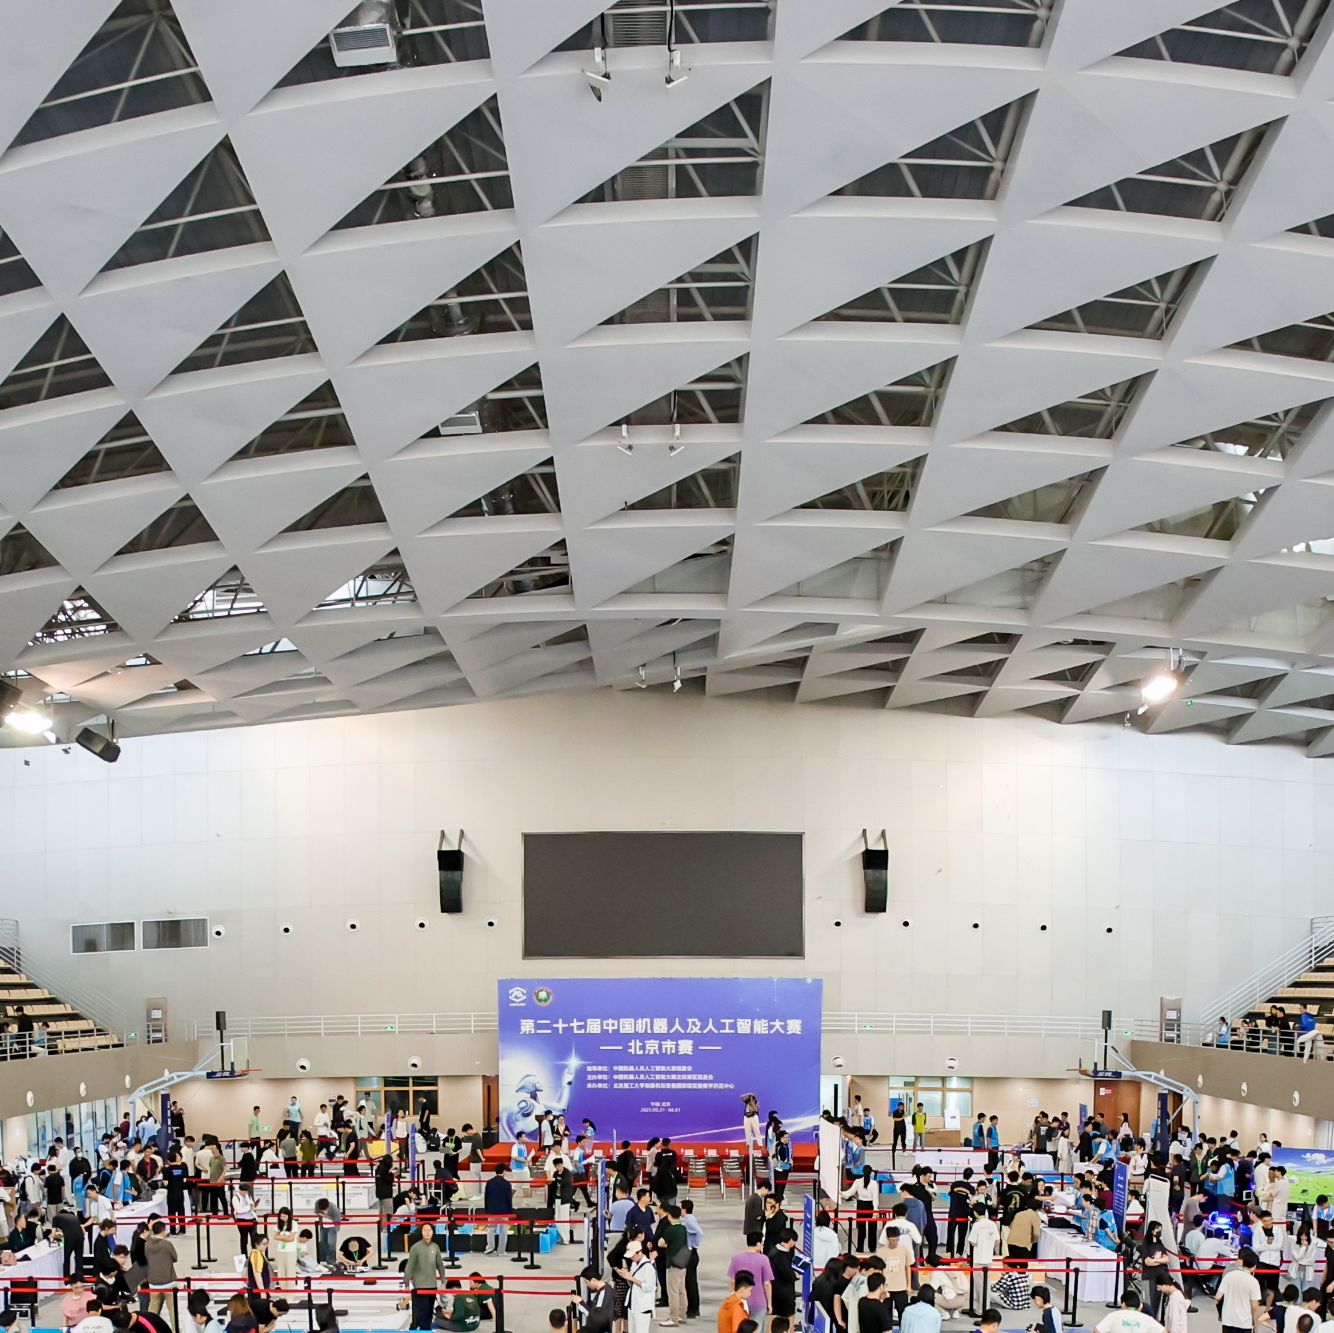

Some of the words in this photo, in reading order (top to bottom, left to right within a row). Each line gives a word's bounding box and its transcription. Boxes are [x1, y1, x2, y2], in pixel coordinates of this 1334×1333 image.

[520, 1018, 802, 1035] 第二十七届中国机器人及人工智能大赛
[628, 1039, 693, 1055] 北京市赛
